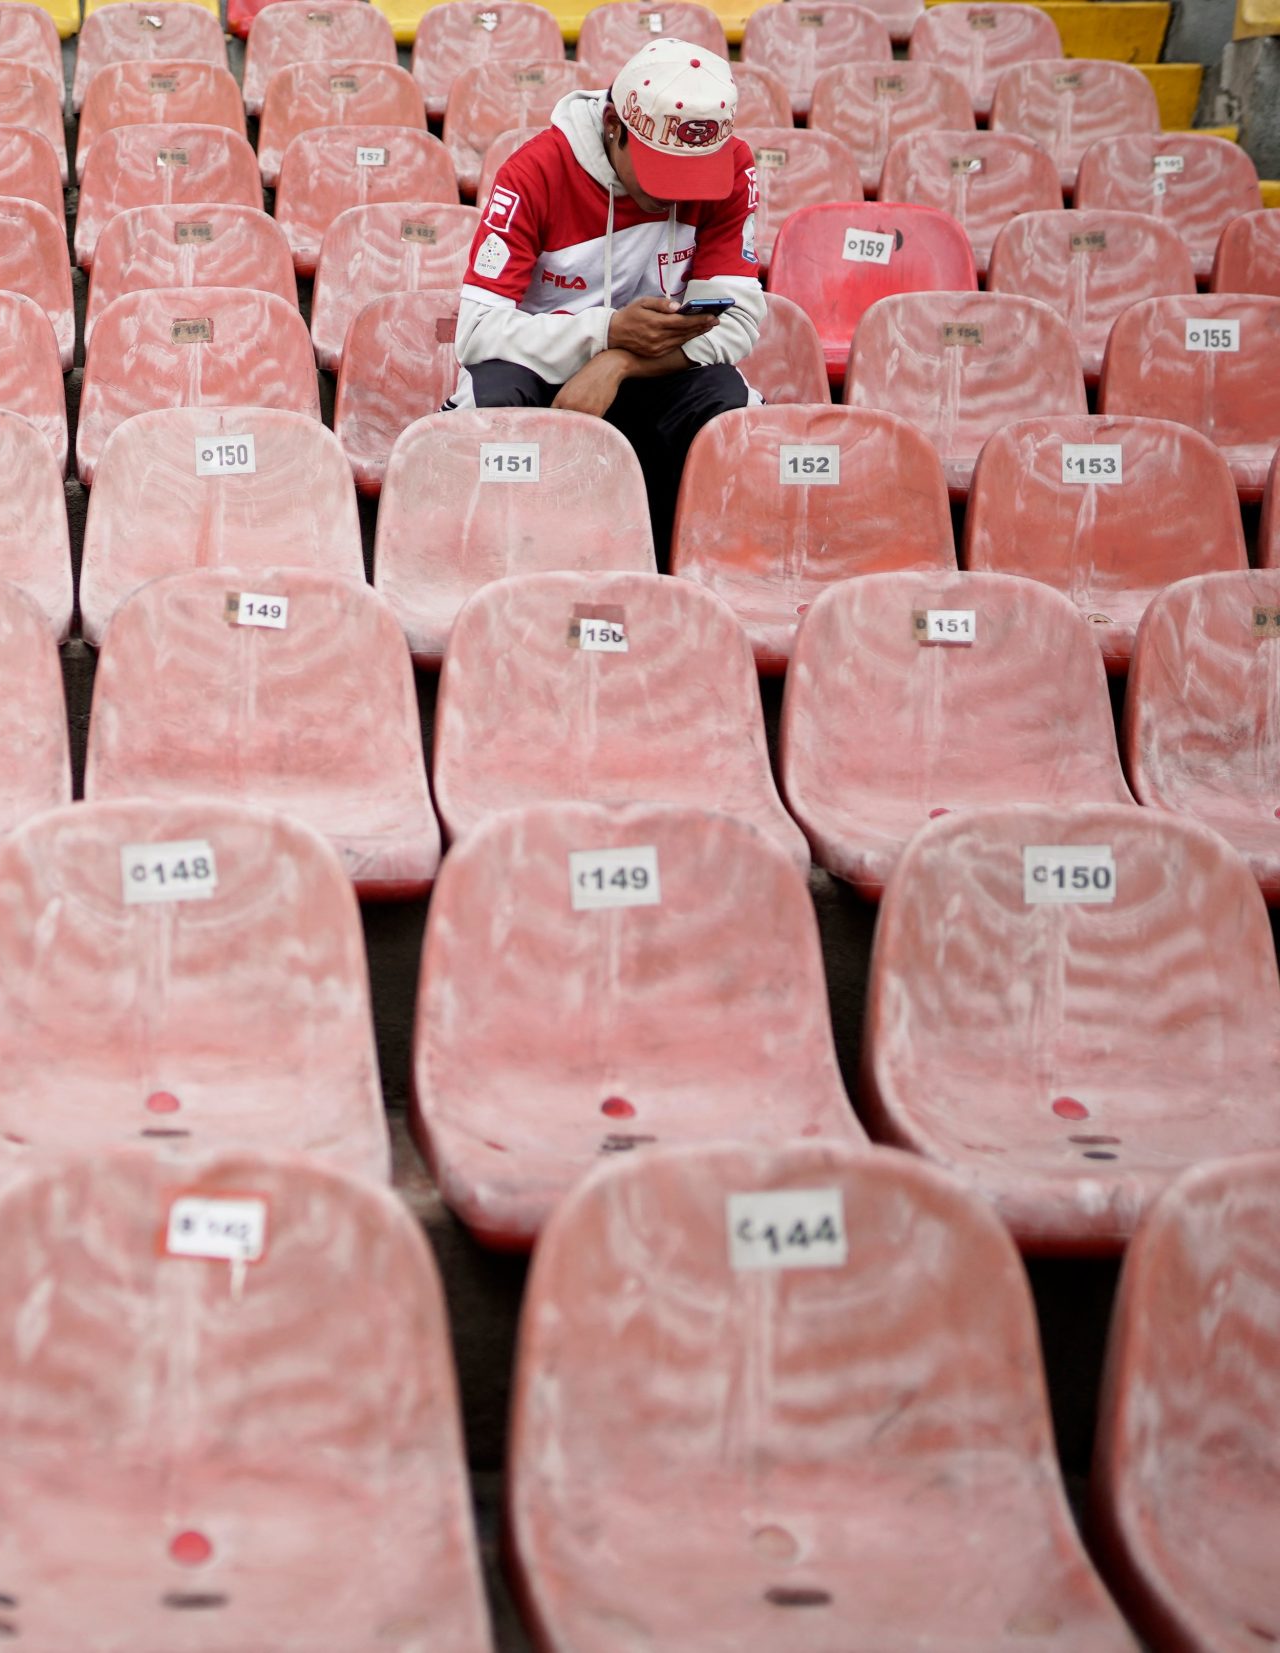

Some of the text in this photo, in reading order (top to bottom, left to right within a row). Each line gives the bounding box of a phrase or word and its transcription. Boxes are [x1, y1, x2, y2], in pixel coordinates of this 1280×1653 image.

[622, 90, 655, 141] San
[360, 151, 380, 161] 157
[858, 240, 885, 259] 159
[541, 269, 587, 290] FILA
[1202, 328, 1232, 348] 155
[216, 444, 248, 466] 150
[788, 456, 830, 474] 152
[245, 603, 281, 618] 149
[935, 618, 970, 633] 151
